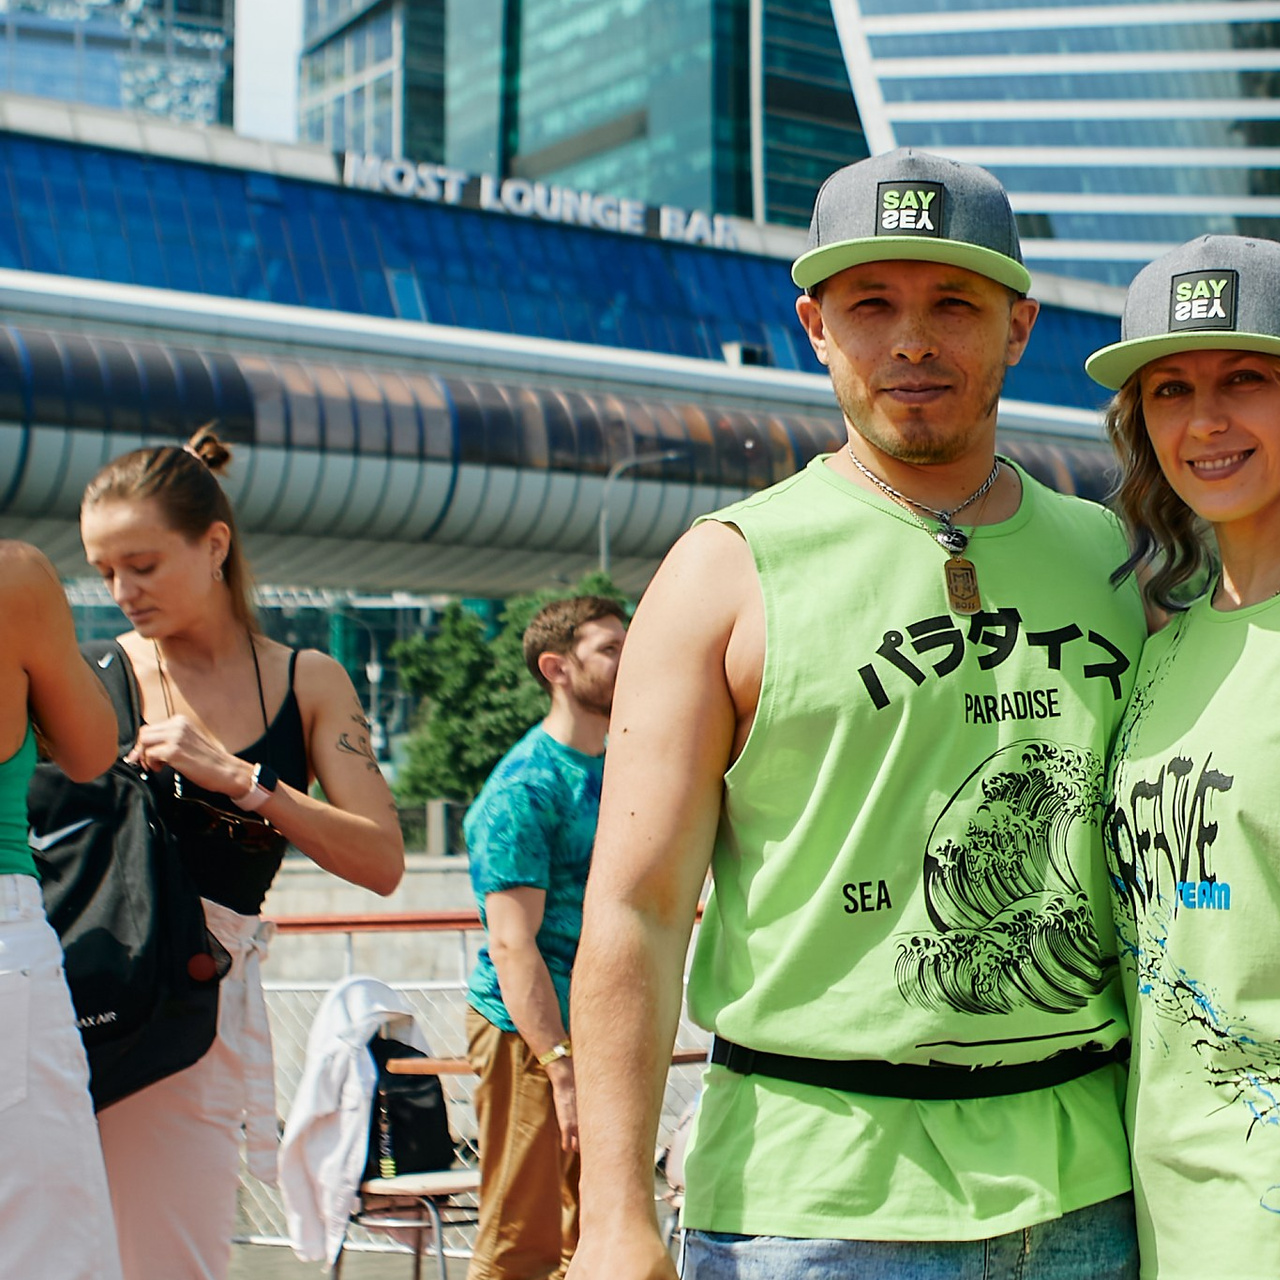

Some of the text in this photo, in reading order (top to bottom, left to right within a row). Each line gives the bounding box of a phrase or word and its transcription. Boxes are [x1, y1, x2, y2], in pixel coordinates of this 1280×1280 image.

[343, 151, 741, 250] MOST LOUNGE BAR
[882, 190, 936, 210] SAY
[1175, 279, 1228, 302] SAY
[964, 688, 1062, 724] PARADISE
[842, 879, 892, 914] SEA
